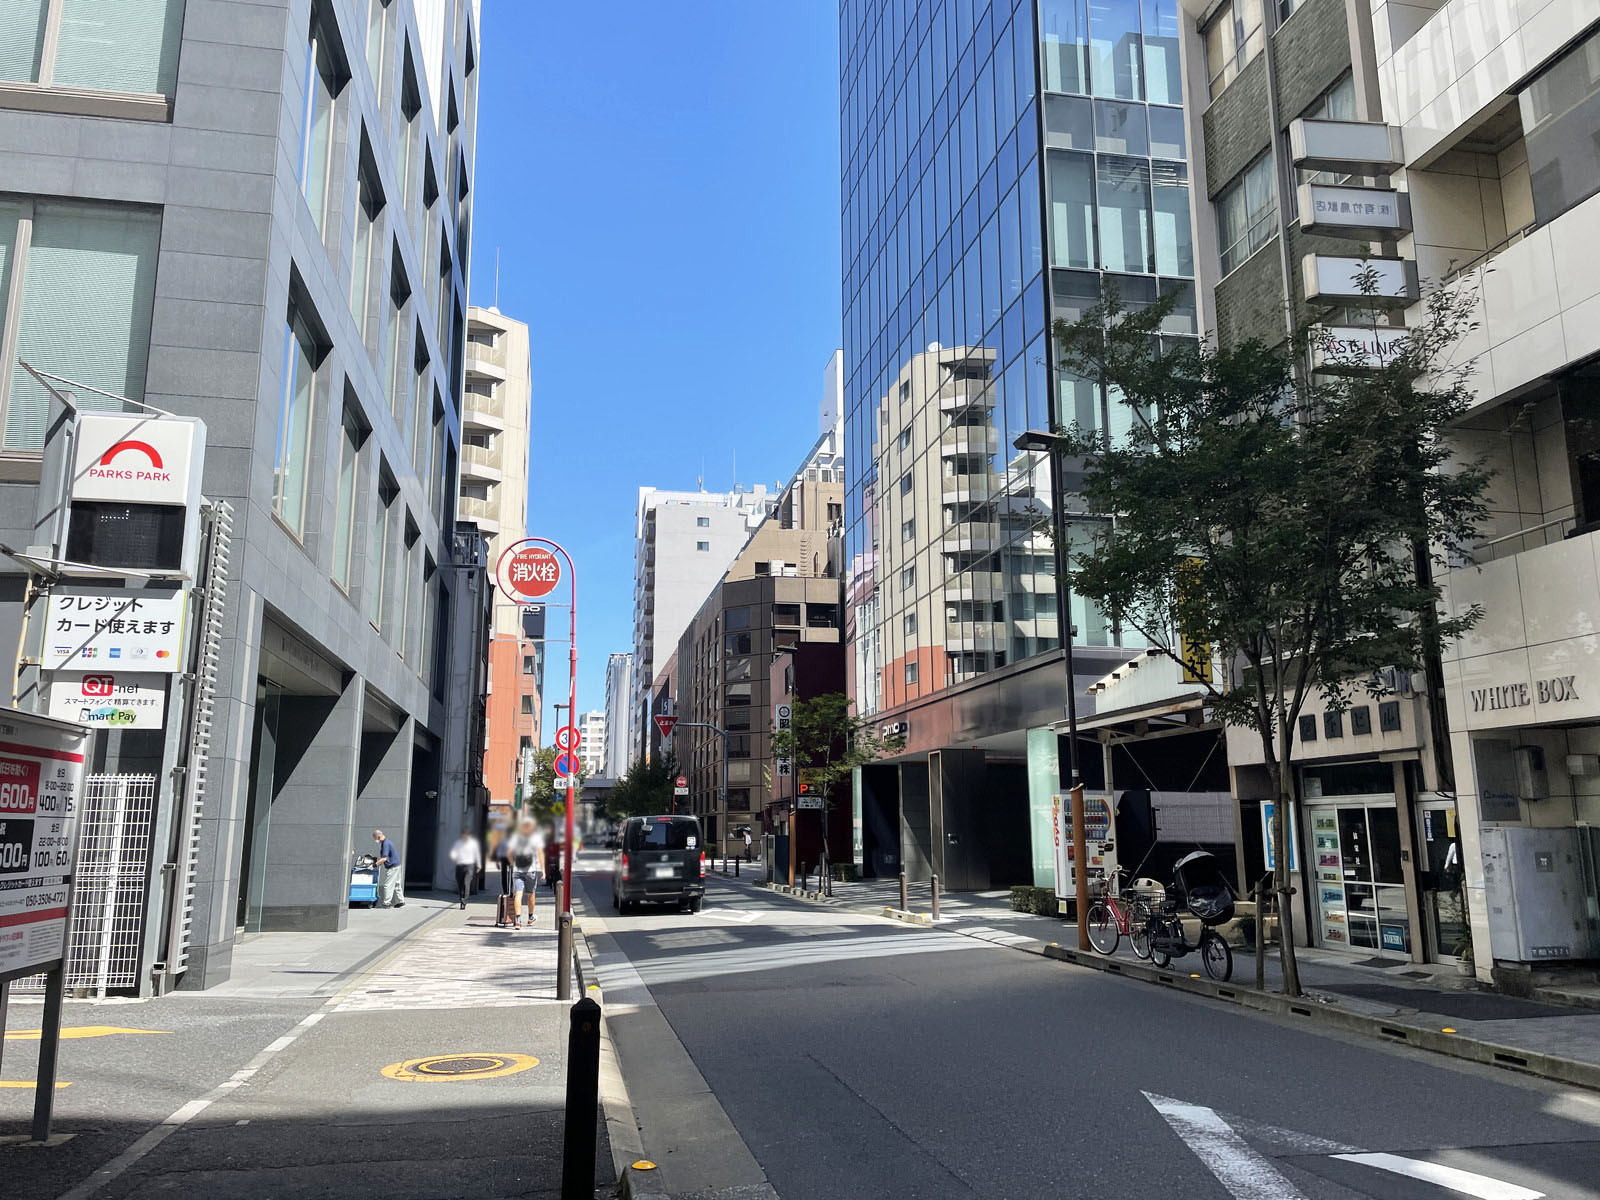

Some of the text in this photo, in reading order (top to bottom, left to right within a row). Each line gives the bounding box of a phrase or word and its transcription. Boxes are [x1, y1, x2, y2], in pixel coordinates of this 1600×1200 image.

[90, 468, 171, 482] PARKS PARK
[512, 562, 556, 582] 消火栓
[60, 597, 143, 612] クレジット
[57, 618, 175, 635] カード使えます
[1471, 675, 1580, 712] WHITE BOX
[80, 709, 137, 723] Smart Pay
[882, 722, 899, 743] pmo
[800, 784, 808, 794] P
